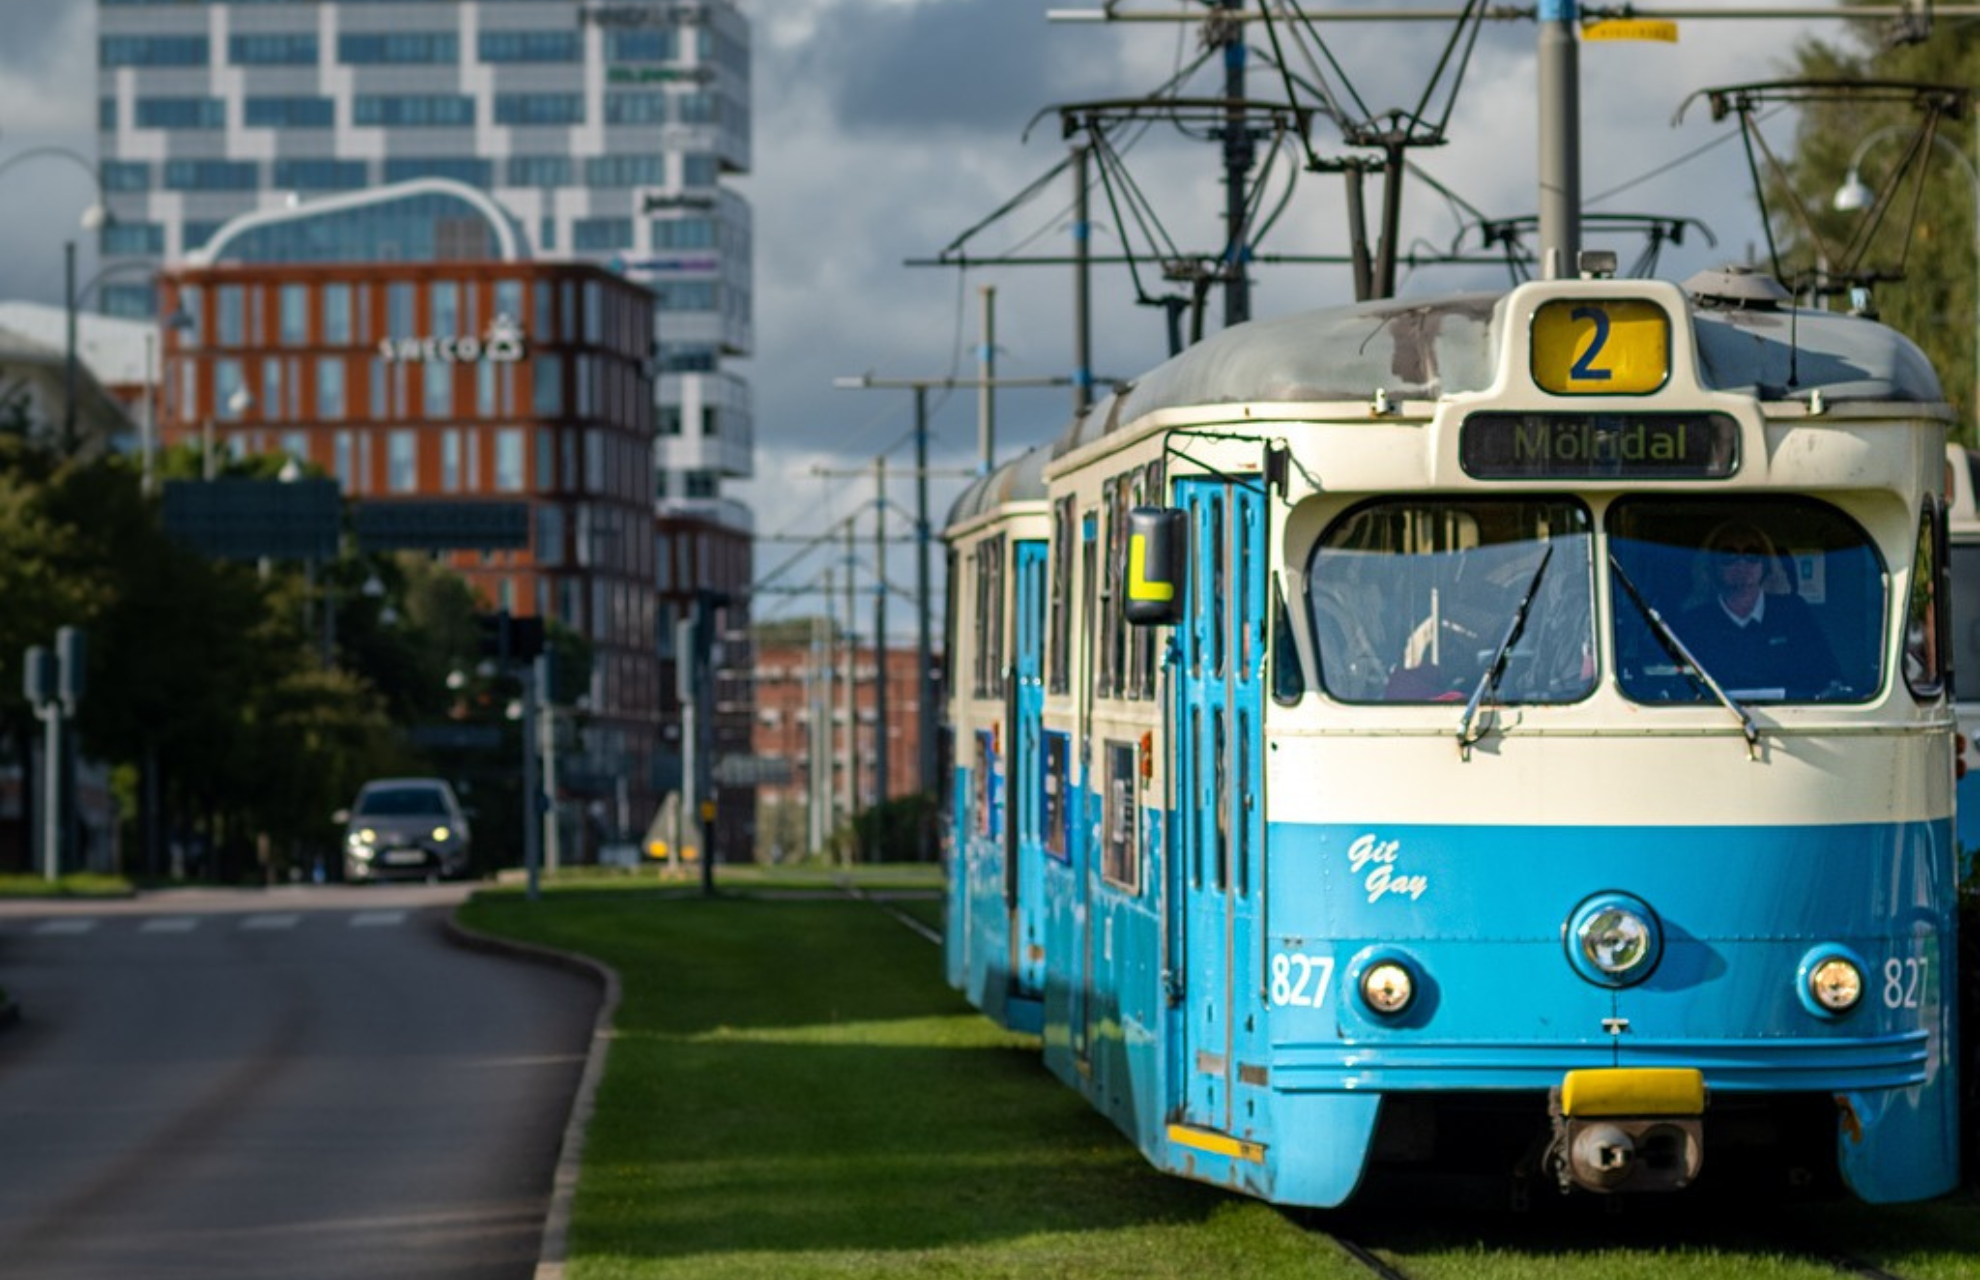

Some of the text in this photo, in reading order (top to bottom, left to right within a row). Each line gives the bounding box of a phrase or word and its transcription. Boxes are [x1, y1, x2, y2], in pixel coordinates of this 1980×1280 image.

[1570, 306, 1612, 381] 2
[1513, 423, 1687, 460] Mölndal
[1347, 833, 1400, 873] Git
[1364, 863, 1428, 904] Gay
[1272, 952, 1335, 1009] 827
[1883, 957, 1929, 1009] 827
